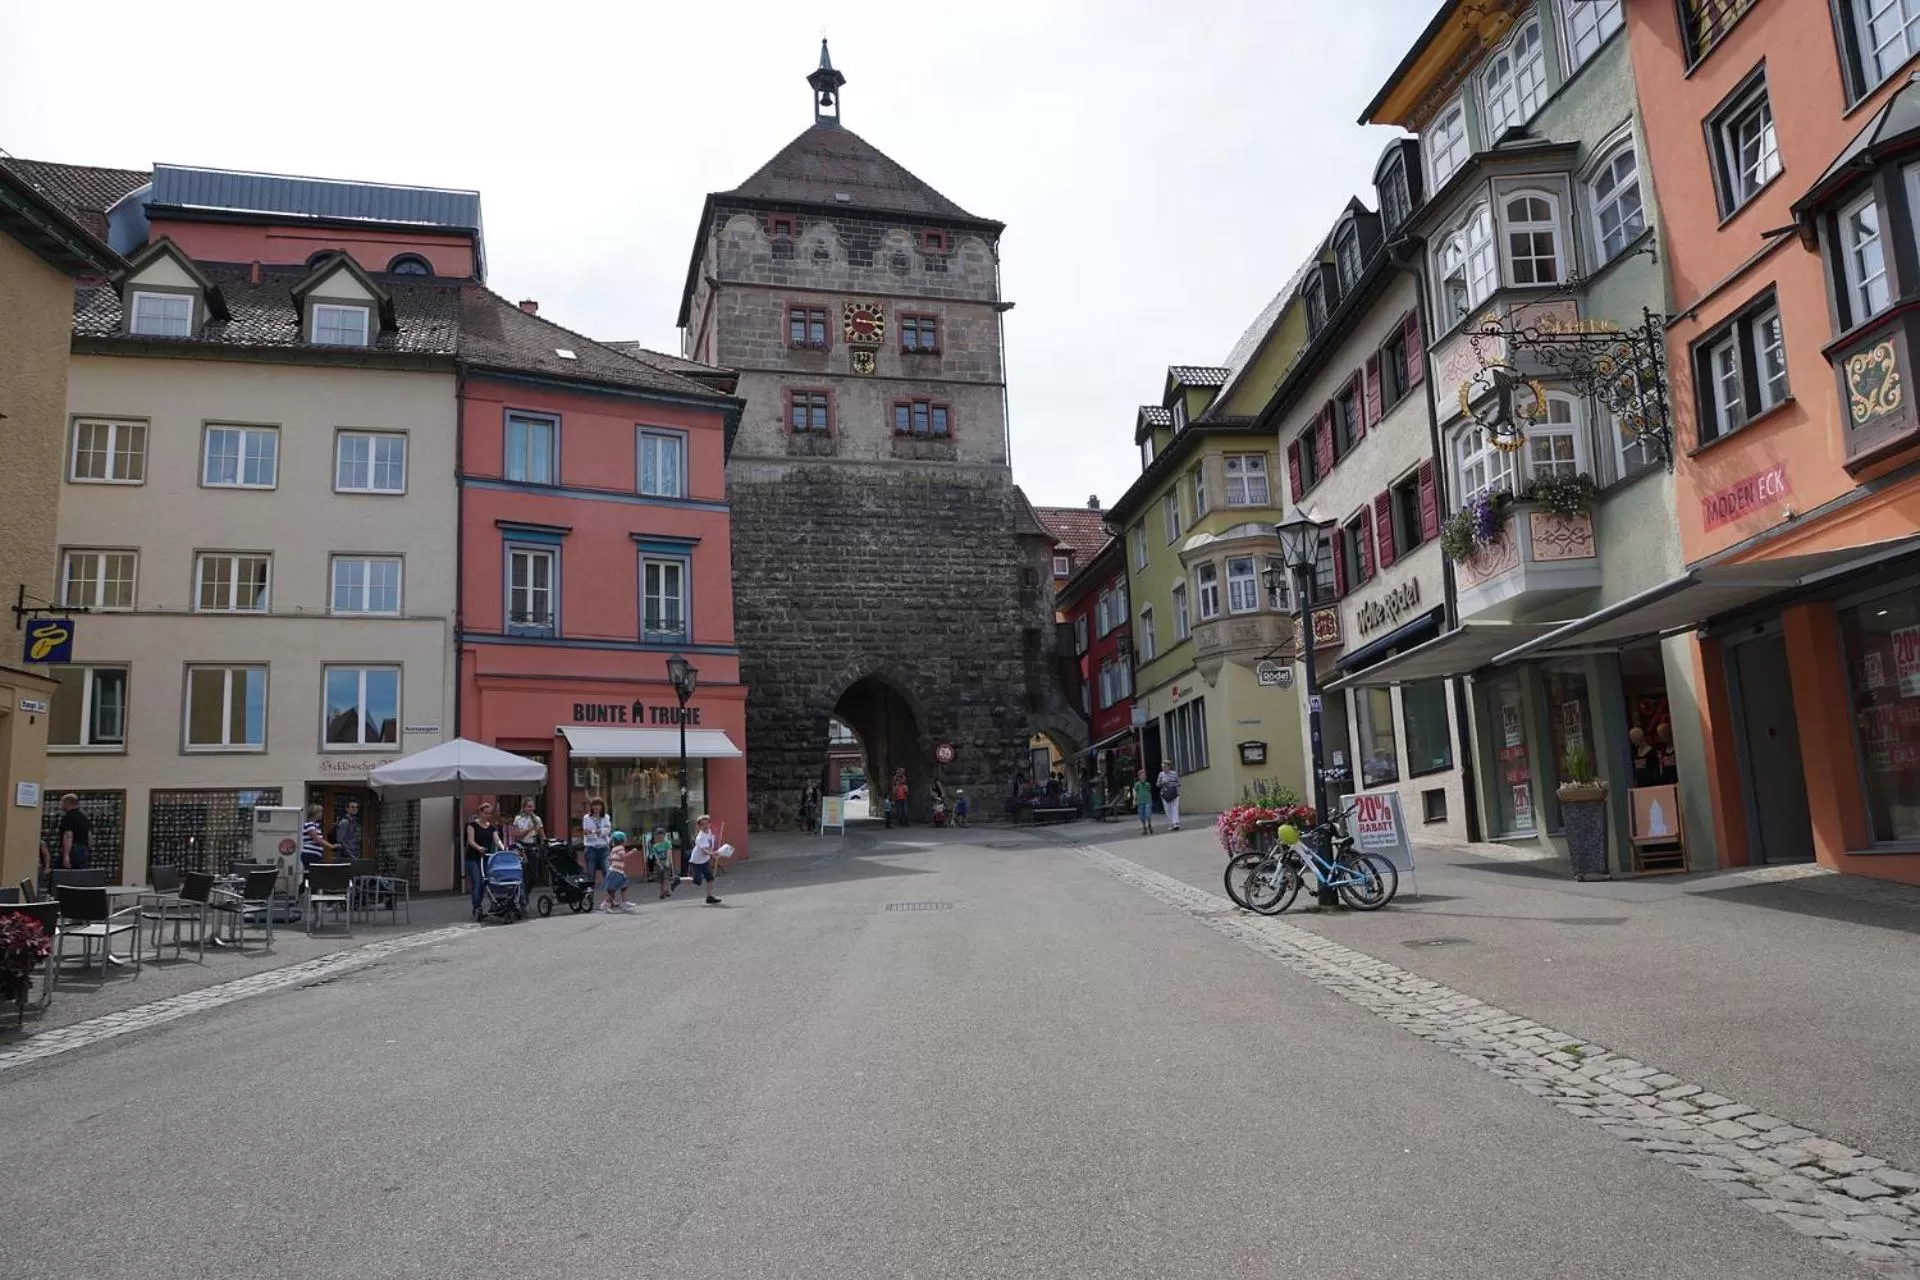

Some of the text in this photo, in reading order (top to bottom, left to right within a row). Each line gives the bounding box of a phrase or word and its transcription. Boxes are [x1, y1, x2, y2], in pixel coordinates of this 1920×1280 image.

[1707, 469, 1784, 524] MODEN ECK
[573, 702, 701, 725] BUNTE TRUHE
[1354, 796, 1391, 823] 20%
[1359, 821, 1392, 833] RABATT
